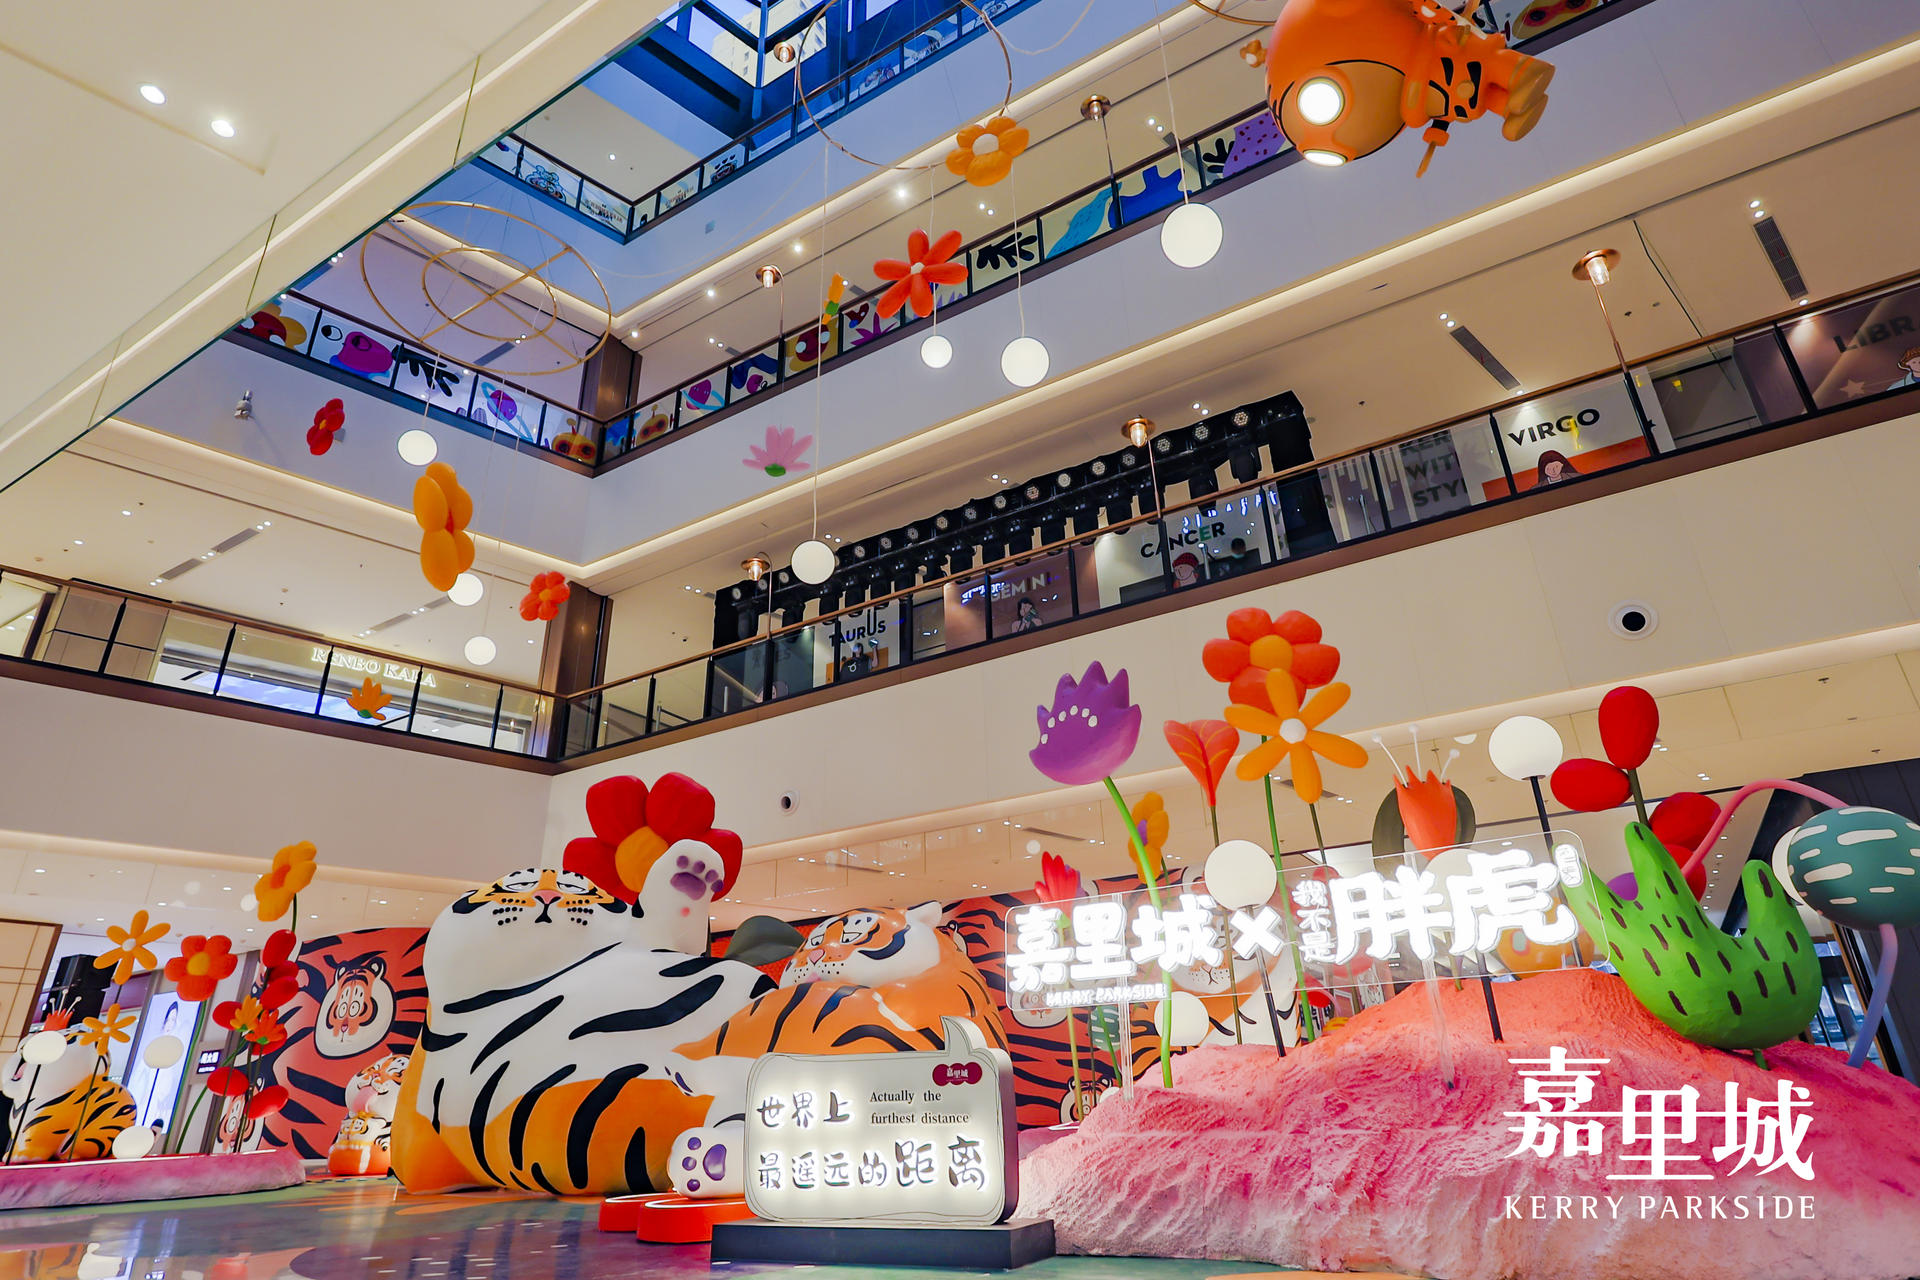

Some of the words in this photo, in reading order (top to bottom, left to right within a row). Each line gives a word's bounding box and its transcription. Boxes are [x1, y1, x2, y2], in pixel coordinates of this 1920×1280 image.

[1833, 315, 1920, 352] LIBR
[1507, 408, 1600, 446] VIRGO
[1404, 450, 1460, 480] WIT
[828, 608, 886, 647] TAURUS
[1006, 893, 1224, 992] 嘉里城
[1327, 849, 1579, 965] 胖虎
[757, 1090, 850, 1128] 世界上
[869, 1090, 915, 1105] Actually
[923, 1090, 942, 1102] the
[871, 1112, 915, 1125] furthest
[921, 1112, 969, 1125] distance
[758, 1135, 985, 1191] 最遥远的距离
